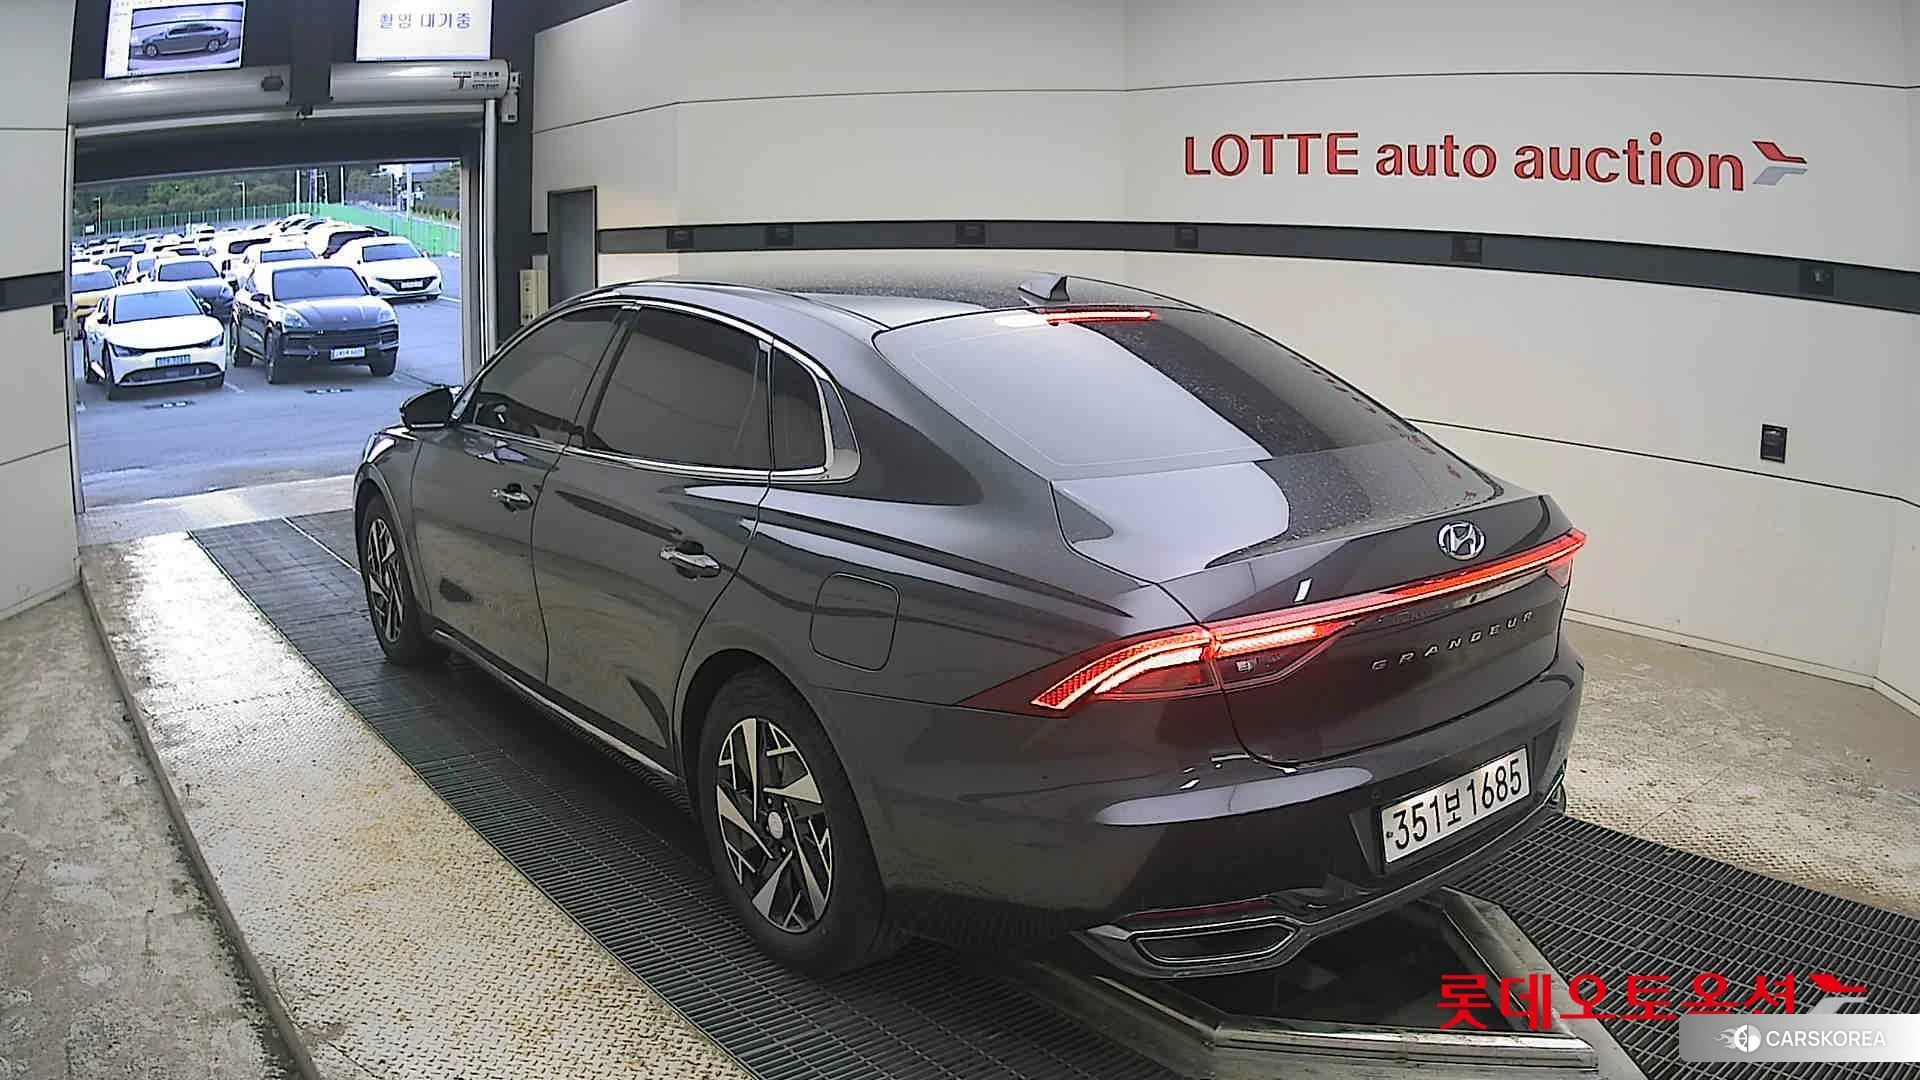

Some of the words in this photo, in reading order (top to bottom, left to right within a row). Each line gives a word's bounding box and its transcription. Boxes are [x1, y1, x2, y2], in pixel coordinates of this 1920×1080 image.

[420, 12, 472, 30] 대기중
[1184, 132, 1360, 177] LOTTE
[1375, 134, 1498, 178] auto
[1514, 131, 1745, 192] auction
[1370, 610, 1534, 672] GRANDEUR
